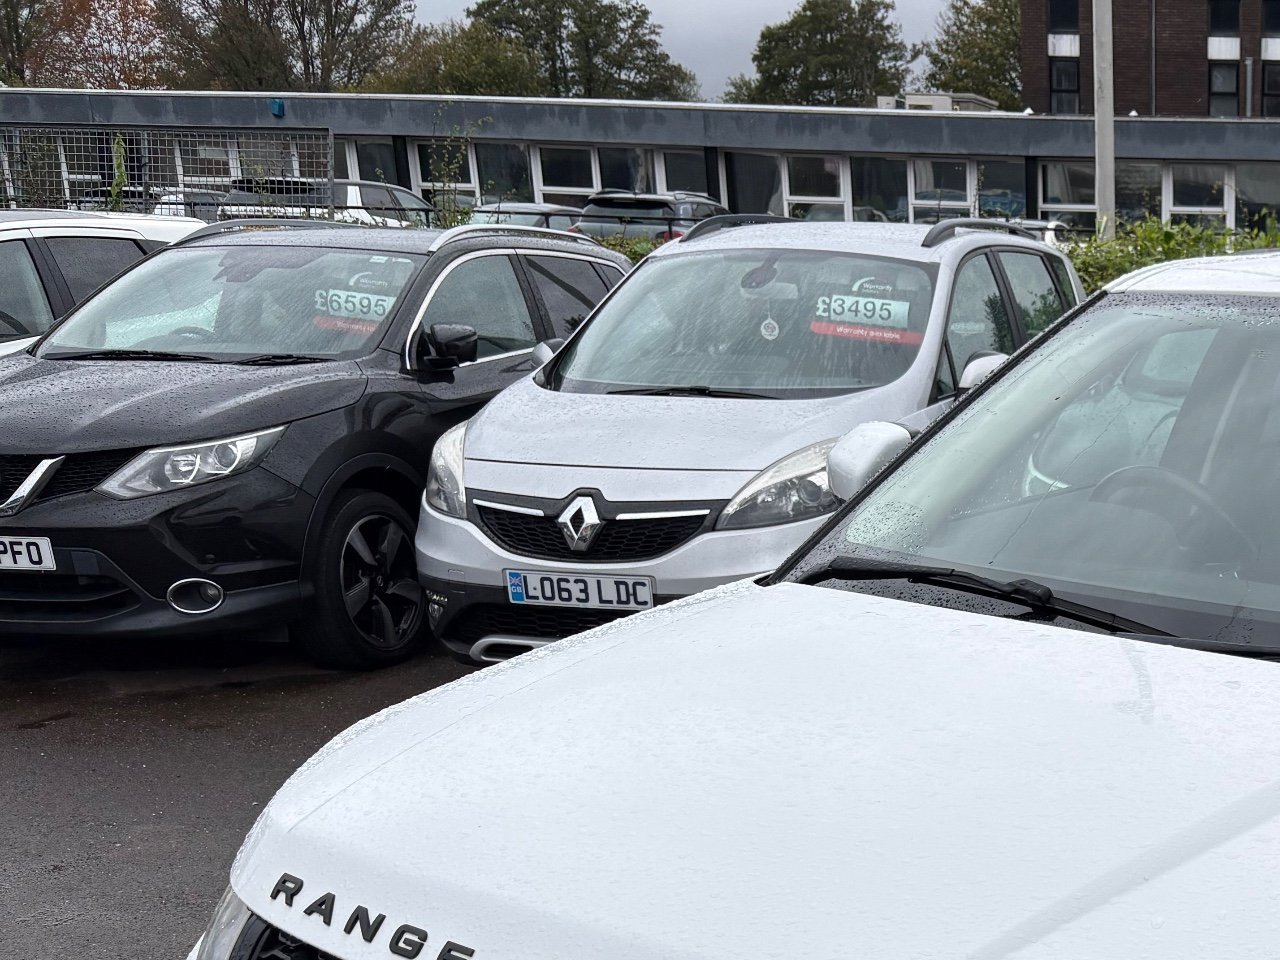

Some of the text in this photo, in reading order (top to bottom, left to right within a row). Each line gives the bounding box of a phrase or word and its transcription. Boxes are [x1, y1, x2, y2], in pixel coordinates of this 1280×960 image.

[315, 289, 387, 317] £6595
[815, 296, 892, 321] £3495
[522, 575, 649, 606] LO63 LDC
